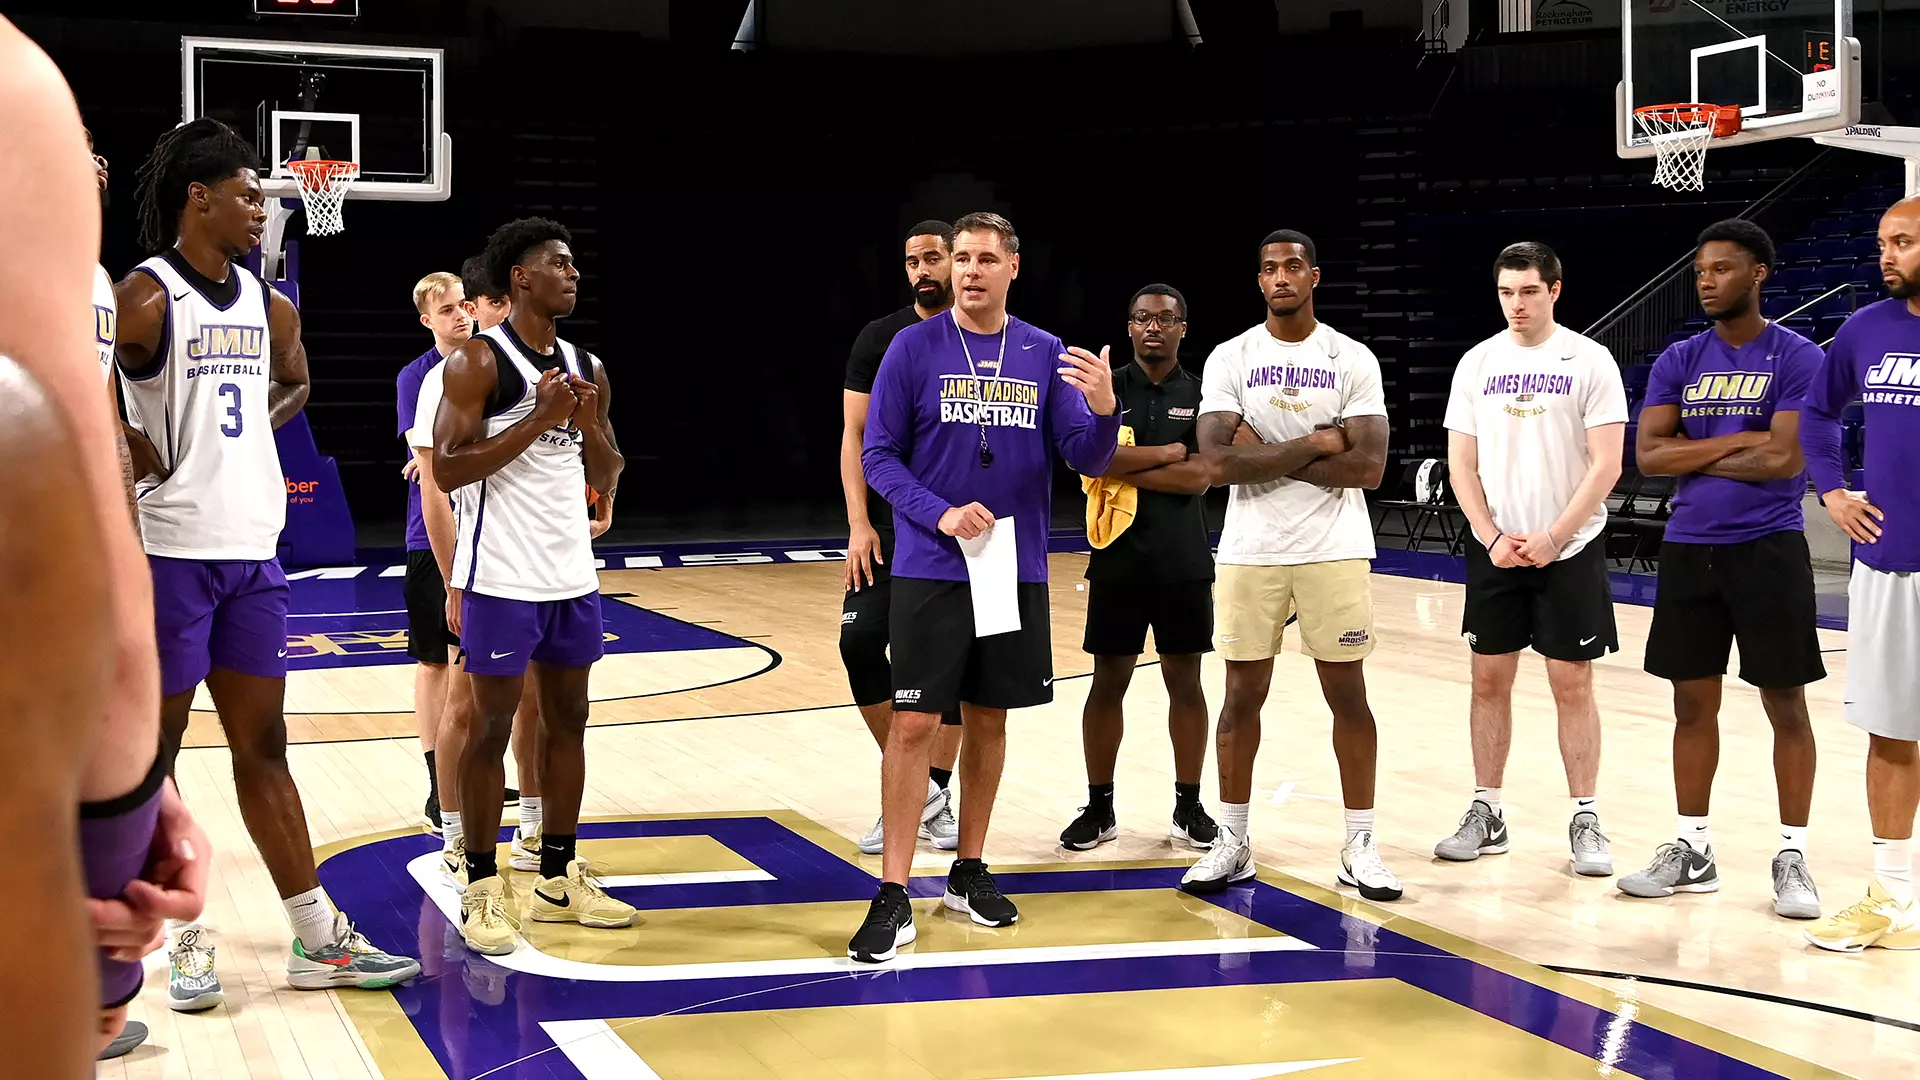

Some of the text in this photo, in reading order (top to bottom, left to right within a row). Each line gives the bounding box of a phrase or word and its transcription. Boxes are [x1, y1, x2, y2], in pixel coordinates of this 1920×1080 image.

[1535, 8, 1593, 19] Rockingham
[1725, 1, 1788, 14] ENERGY
[1535, 17, 1593, 26] PETROLEUM
[1844, 126, 1881, 137] SPALDING
[188, 325, 263, 359] JMU
[186, 364, 262, 379] BASKETBALL
[1246, 365, 1336, 389] JAMES MADISON
[1864, 352, 1920, 390] JM
[1483, 373, 1573, 395] JAMES MADISON
[1683, 371, 1772, 403] JMU
[940, 379, 1038, 405] JAMES MADISON
[1862, 392, 1920, 406] BASKETB
[218, 383, 243, 438] 3
[1269, 396, 1312, 412] BASKEBALL
[1503, 403, 1547, 418] BASKEALL
[940, 402, 1037, 429] BASKETBALL
[1681, 406, 1763, 418] BASKETBALL
[285, 477, 319, 493] ber
[1338, 635, 1369, 643] MADISON
[1342, 629, 1366, 637] JAMES
